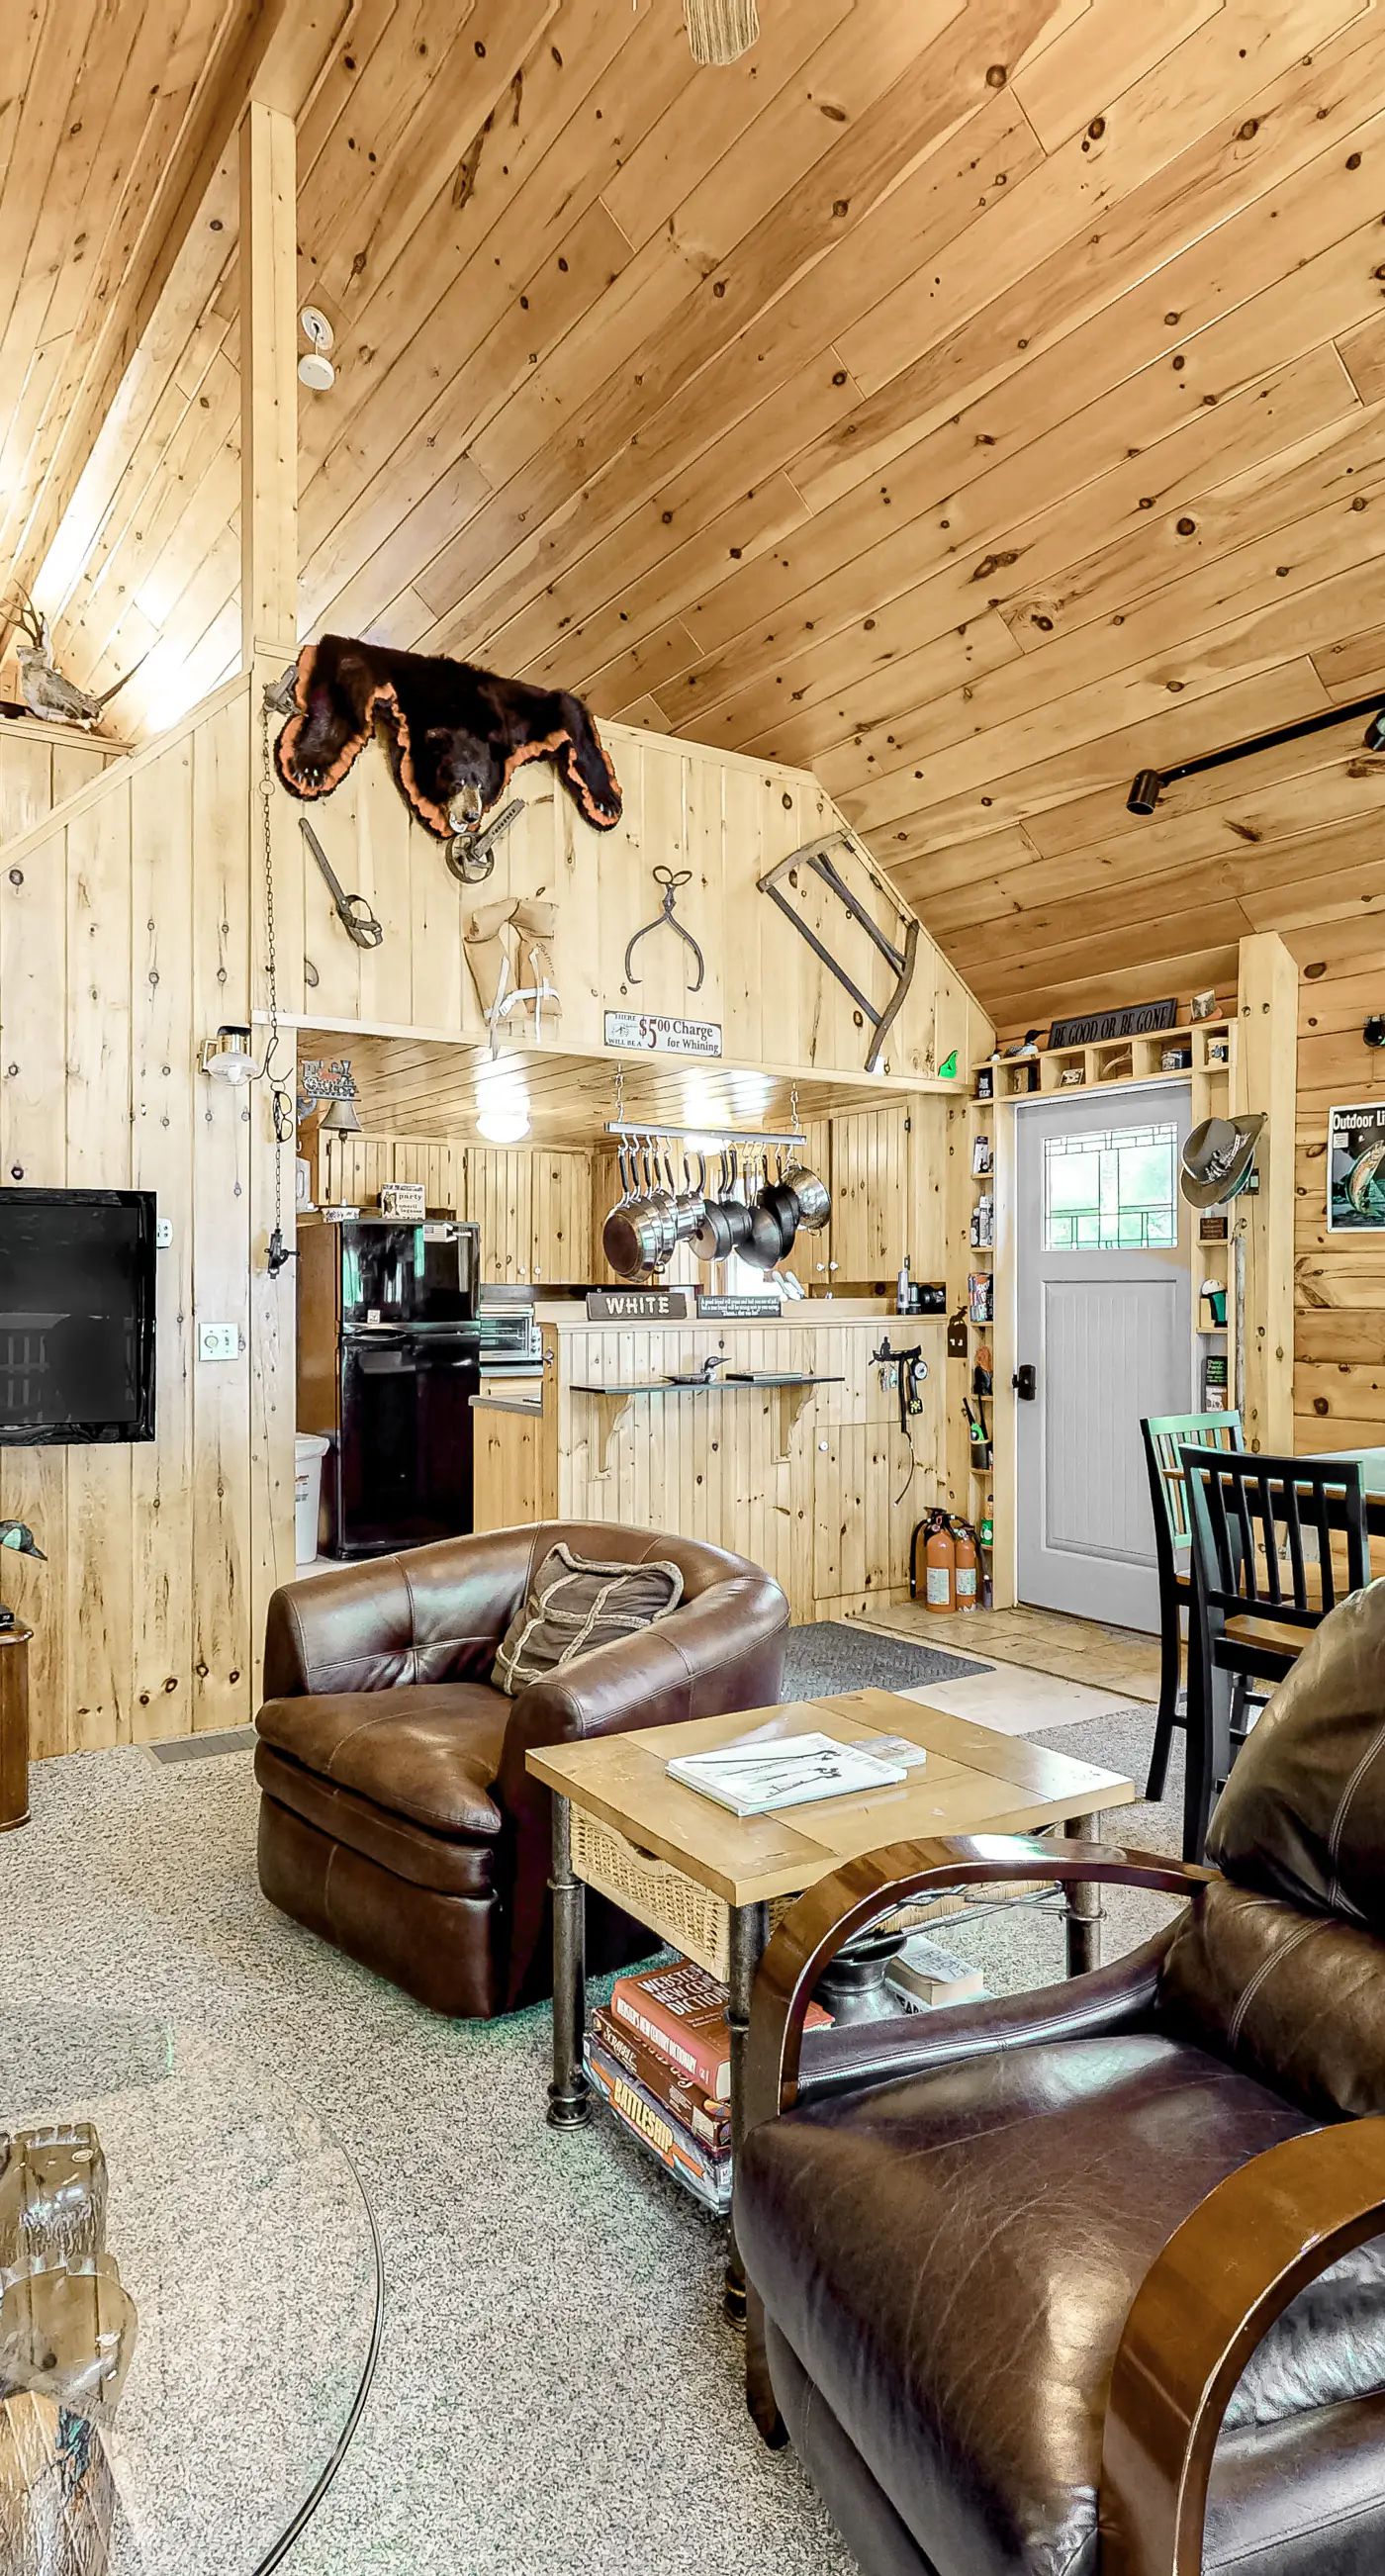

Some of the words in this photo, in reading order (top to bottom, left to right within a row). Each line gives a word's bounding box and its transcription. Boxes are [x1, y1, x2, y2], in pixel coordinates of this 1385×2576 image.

[673, 1020, 713, 1041] Charge
[1054, 1027, 1067, 1048] BE
[1068, 1021, 1098, 1045] GOOD
[1101, 1017, 1116, 1039] OR
[1120, 1013, 1135, 1036] BE
[1137, 1006, 1167, 1032] GONE
[667, 1037, 681, 1048] for
[682, 1038, 719, 1055] Whining
[1334, 1113, 1374, 1131] Outdoor
[605, 1296, 670, 1315] WHITE
[652, 1986, 689, 2004] NEW
[613, 2075, 674, 2154] BATTLESHIP
